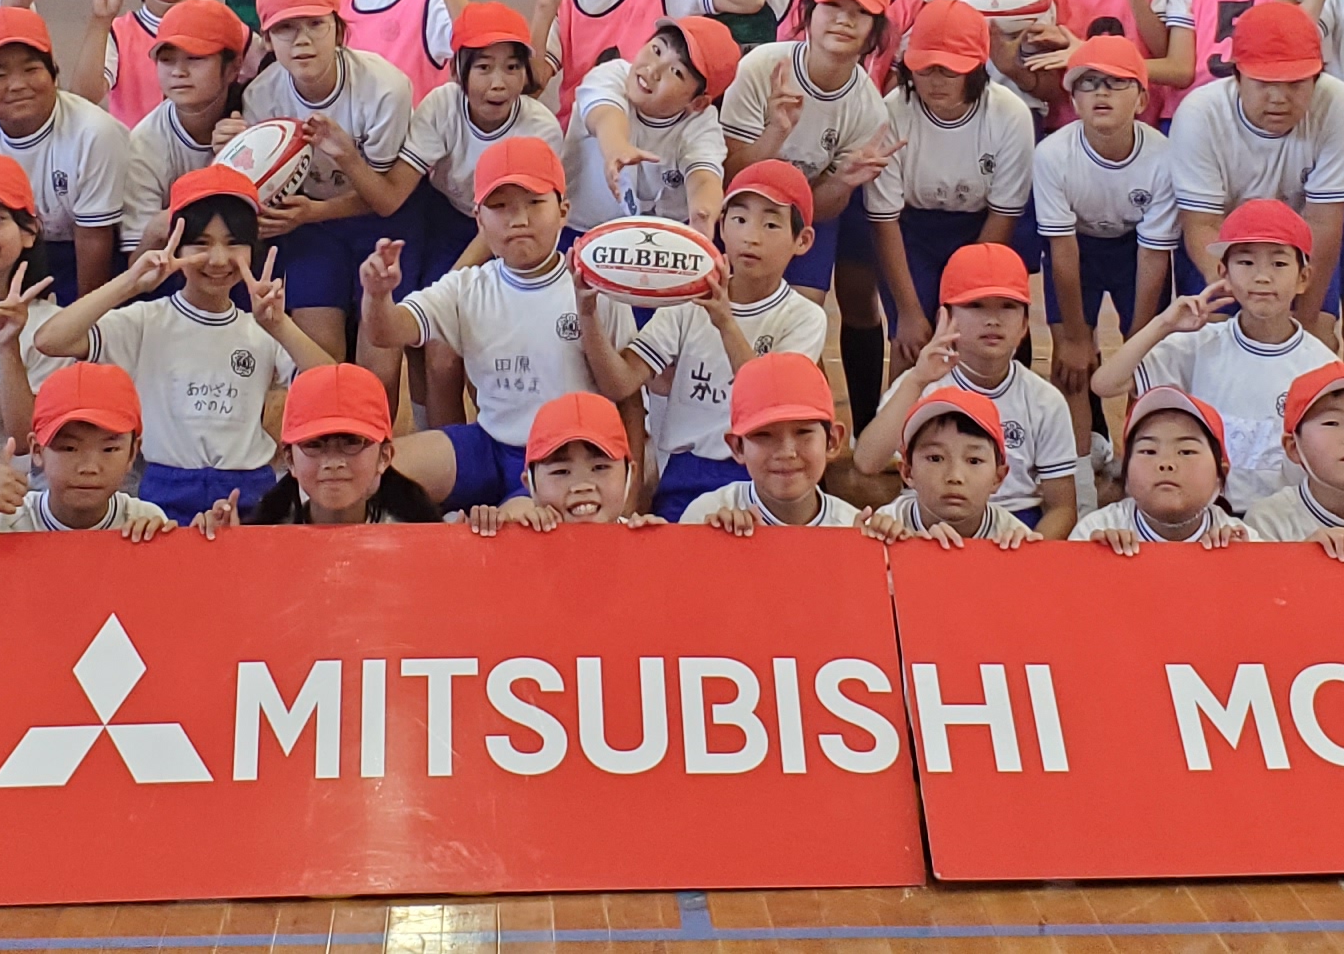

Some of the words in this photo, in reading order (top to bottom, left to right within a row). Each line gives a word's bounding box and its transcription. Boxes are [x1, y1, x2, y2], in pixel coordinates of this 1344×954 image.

[592, 246, 704, 272] GILBERT
[495, 355, 531, 373] 田原
[233, 657, 1070, 781] MITSUBISHI
